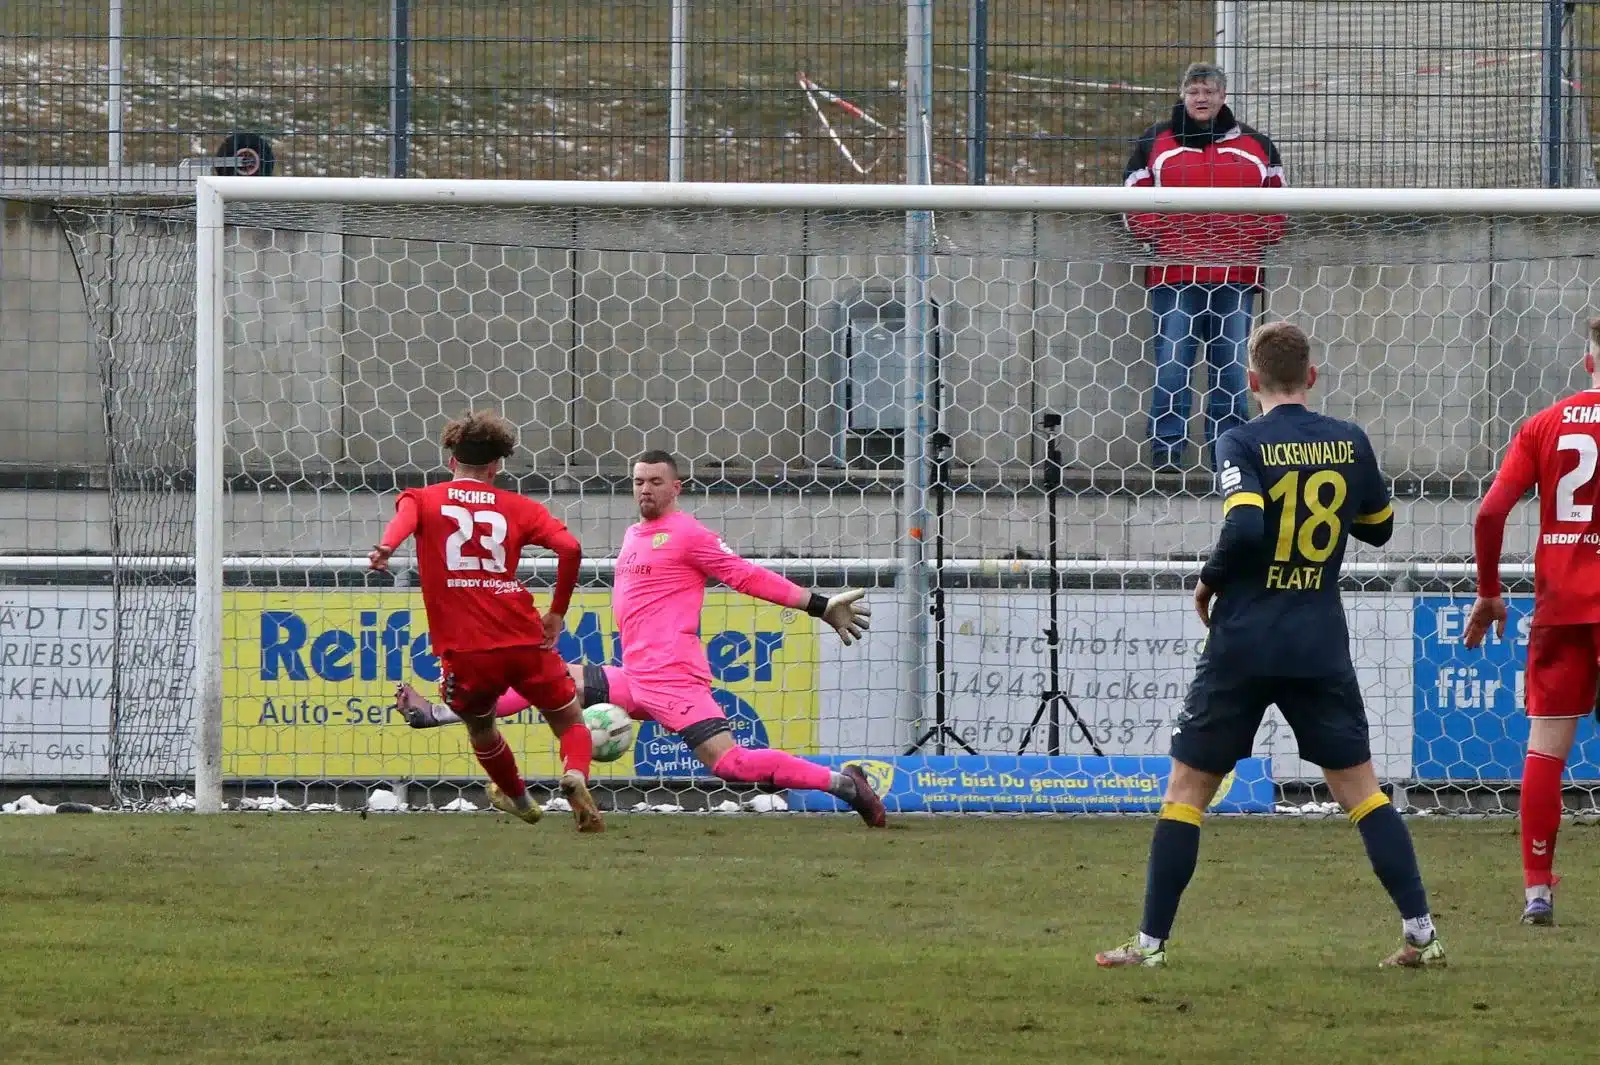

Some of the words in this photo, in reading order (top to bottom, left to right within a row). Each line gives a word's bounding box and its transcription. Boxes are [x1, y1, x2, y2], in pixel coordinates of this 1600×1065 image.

[1261, 441, 1355, 467] LUCKENWALDE
[1556, 433, 1598, 522] 2
[447, 488, 496, 505] FISCHER
[1268, 469, 1347, 563] 18
[441, 504, 508, 574] 23
[1543, 533, 1583, 545] REDDY
[447, 578, 481, 588] REDDY
[1266, 565, 1324, 590] FLATH
[260, 611, 441, 682] Reife
[0, 676, 184, 700] KENWALDE
[950, 671, 1047, 699] 14943
[1434, 666, 1502, 709] für
[1069, 718, 1164, 745] 0337
[46, 743, 85, 760] GAS
[654, 759, 678, 773] Am
[917, 772, 957, 787] Hier
[960, 771, 996, 787] bist
[999, 773, 1025, 788] Du
[1030, 778, 1089, 792] genau
[1093, 773, 1159, 793] richtig!
